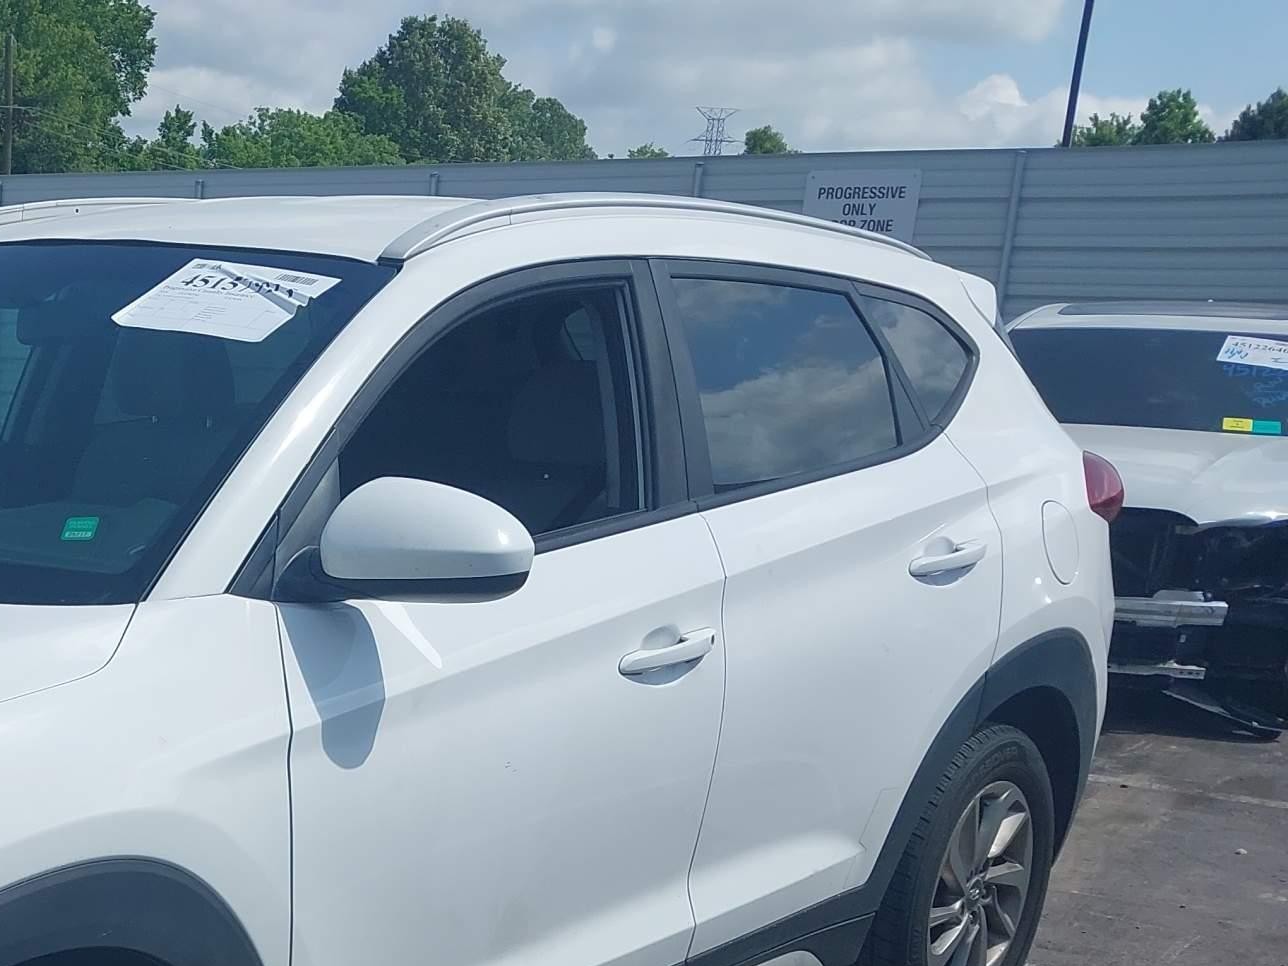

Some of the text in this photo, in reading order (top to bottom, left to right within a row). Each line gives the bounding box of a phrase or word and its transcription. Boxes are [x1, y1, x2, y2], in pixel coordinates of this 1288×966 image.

[817, 186, 907, 200] PROGRESSIVE
[842, 203, 877, 216] ONLY
[858, 219, 894, 232] ZONE
